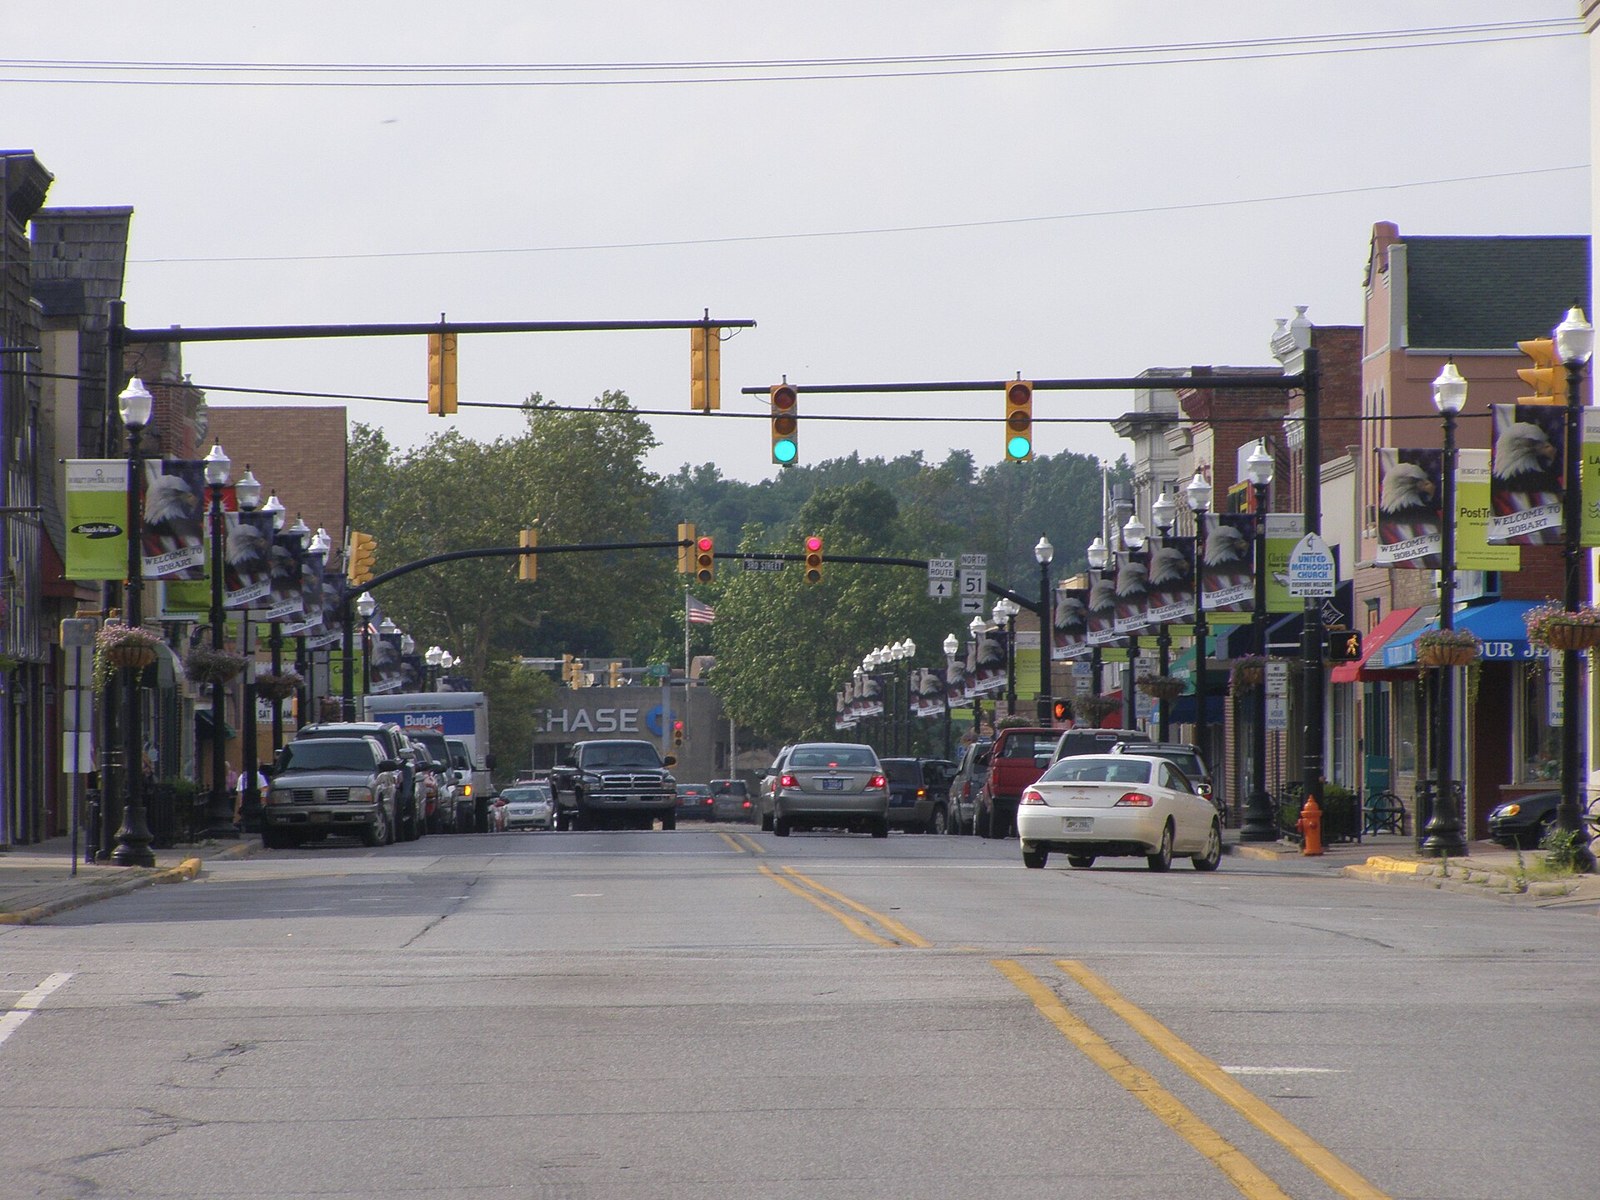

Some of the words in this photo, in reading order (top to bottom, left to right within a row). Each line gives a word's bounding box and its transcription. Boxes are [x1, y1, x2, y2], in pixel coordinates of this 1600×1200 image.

[1493, 507, 1545, 527] WELCOME
[1548, 504, 1561, 514] TO
[1508, 518, 1548, 535] HOBART
[1380, 537, 1426, 553] WELCOME
[1429, 534, 1441, 543] TO
[145, 550, 188, 565] WELCOME
[191, 546, 203, 556] TO
[1299, 555, 1327, 563] UNITED
[1394, 545, 1429, 560] HOBART
[157, 558, 192, 573] HOBART
[760, 561, 782, 570] STREET
[931, 560, 953, 568] TRUCK
[962, 556, 986, 564] NORTH
[1292, 563, 1333, 571] METHODIST
[931, 568, 953, 577] ROUTE
[966, 577, 982, 593] 51
[1204, 586, 1240, 599] WELCOME
[404, 714, 443, 728] Budget
